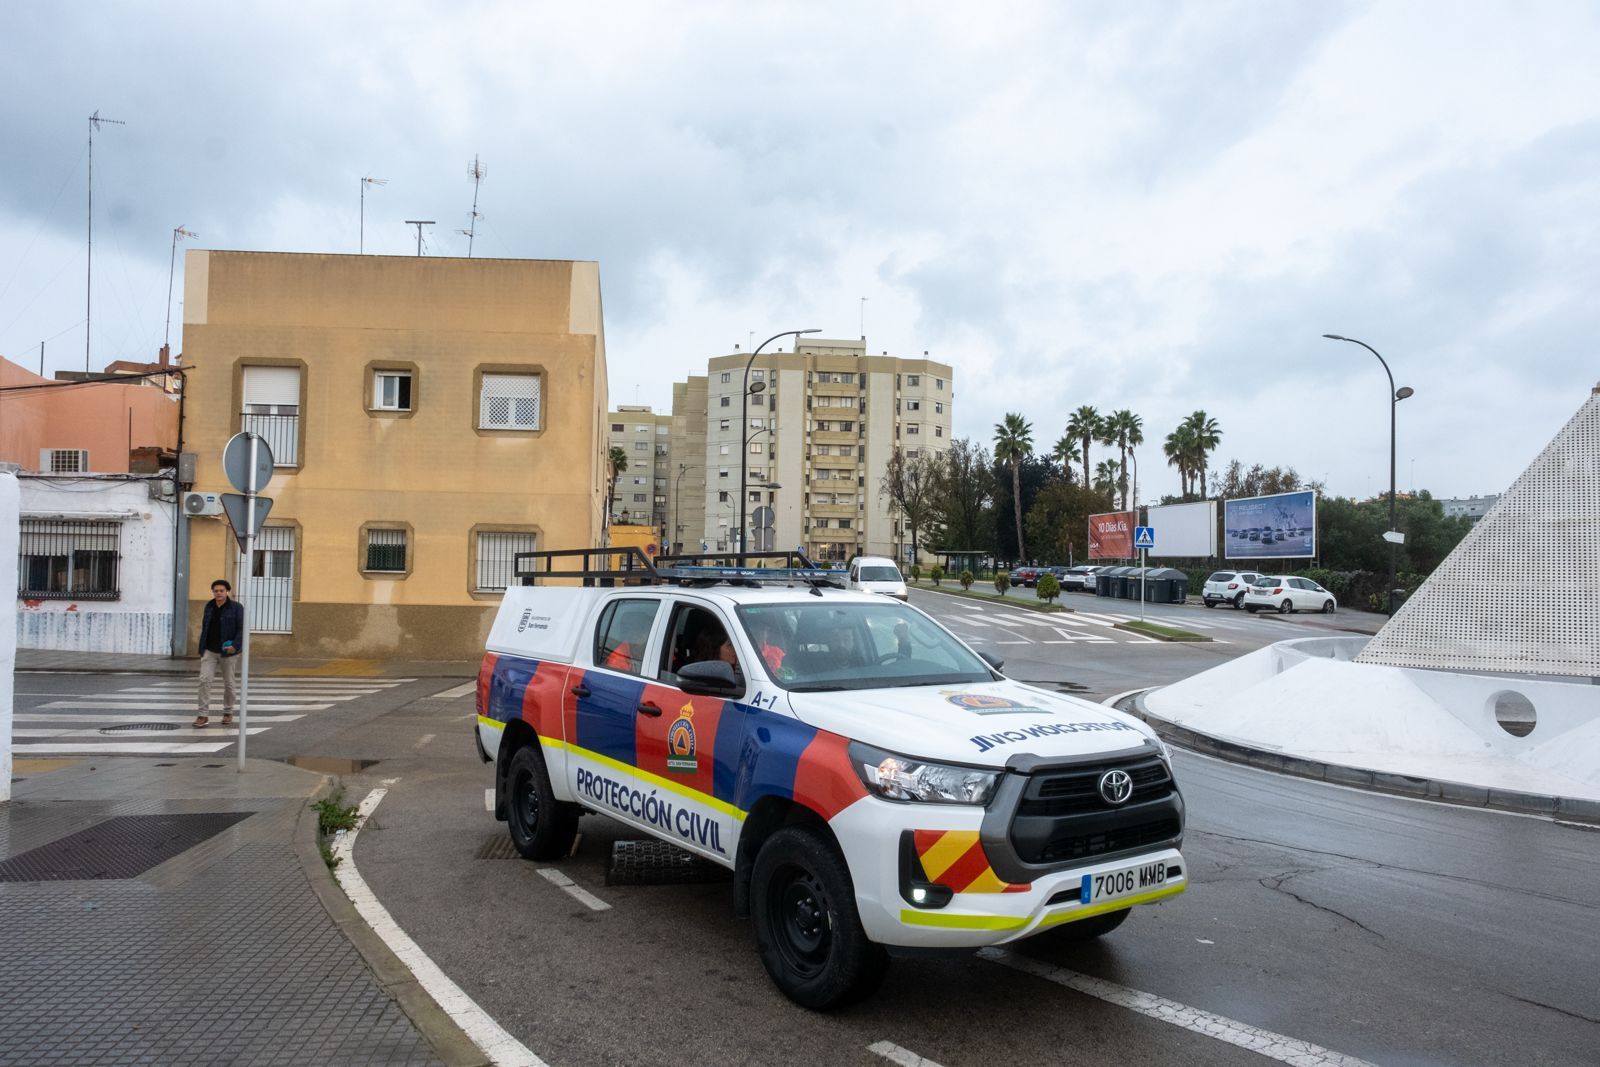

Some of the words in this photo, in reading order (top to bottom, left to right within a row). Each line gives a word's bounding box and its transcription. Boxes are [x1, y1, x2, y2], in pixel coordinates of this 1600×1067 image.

[1099, 522, 1105, 533] 10
[751, 691, 778, 710] A-1
[577, 768, 673, 831] PROTECCIÓN
[675, 808, 726, 854] CIVIL
[1095, 870, 1134, 898] 7006
[1139, 863, 1165, 888] MMB
